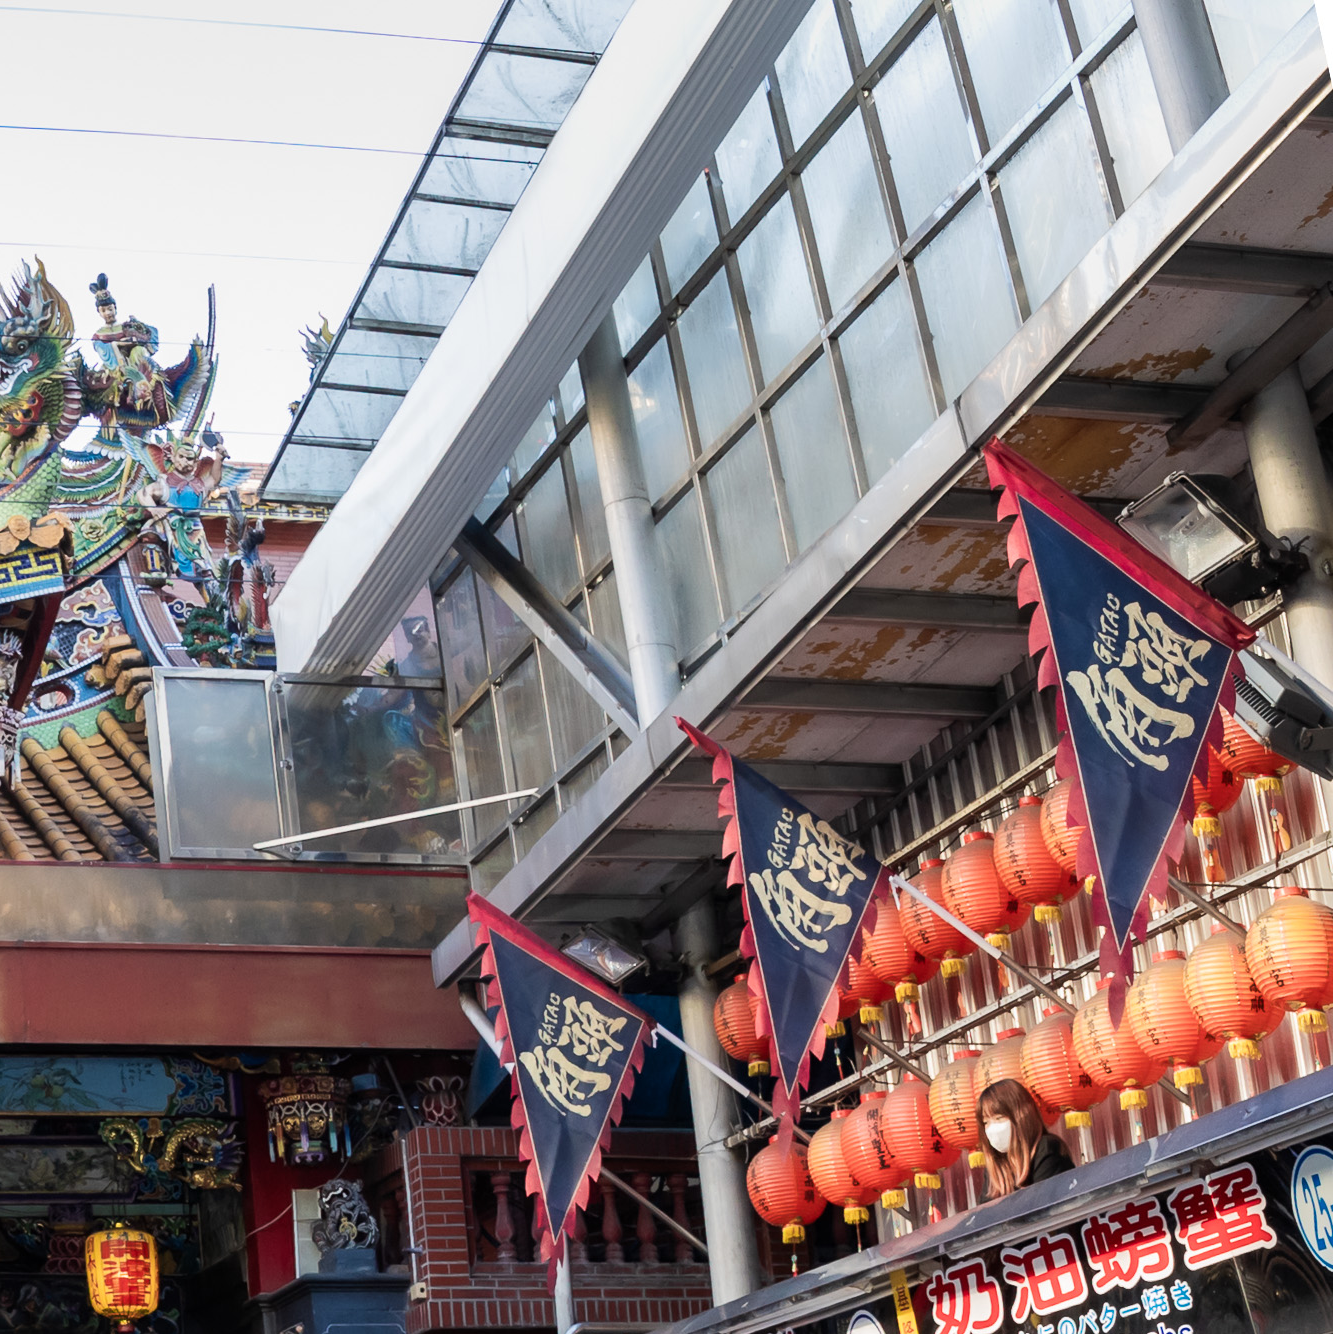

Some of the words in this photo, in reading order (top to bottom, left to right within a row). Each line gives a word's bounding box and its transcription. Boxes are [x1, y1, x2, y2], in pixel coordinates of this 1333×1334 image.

[1095, 592, 1121, 667] GATAO
[769, 806, 795, 873] GATAO
[538, 991, 561, 1047] GATAO
